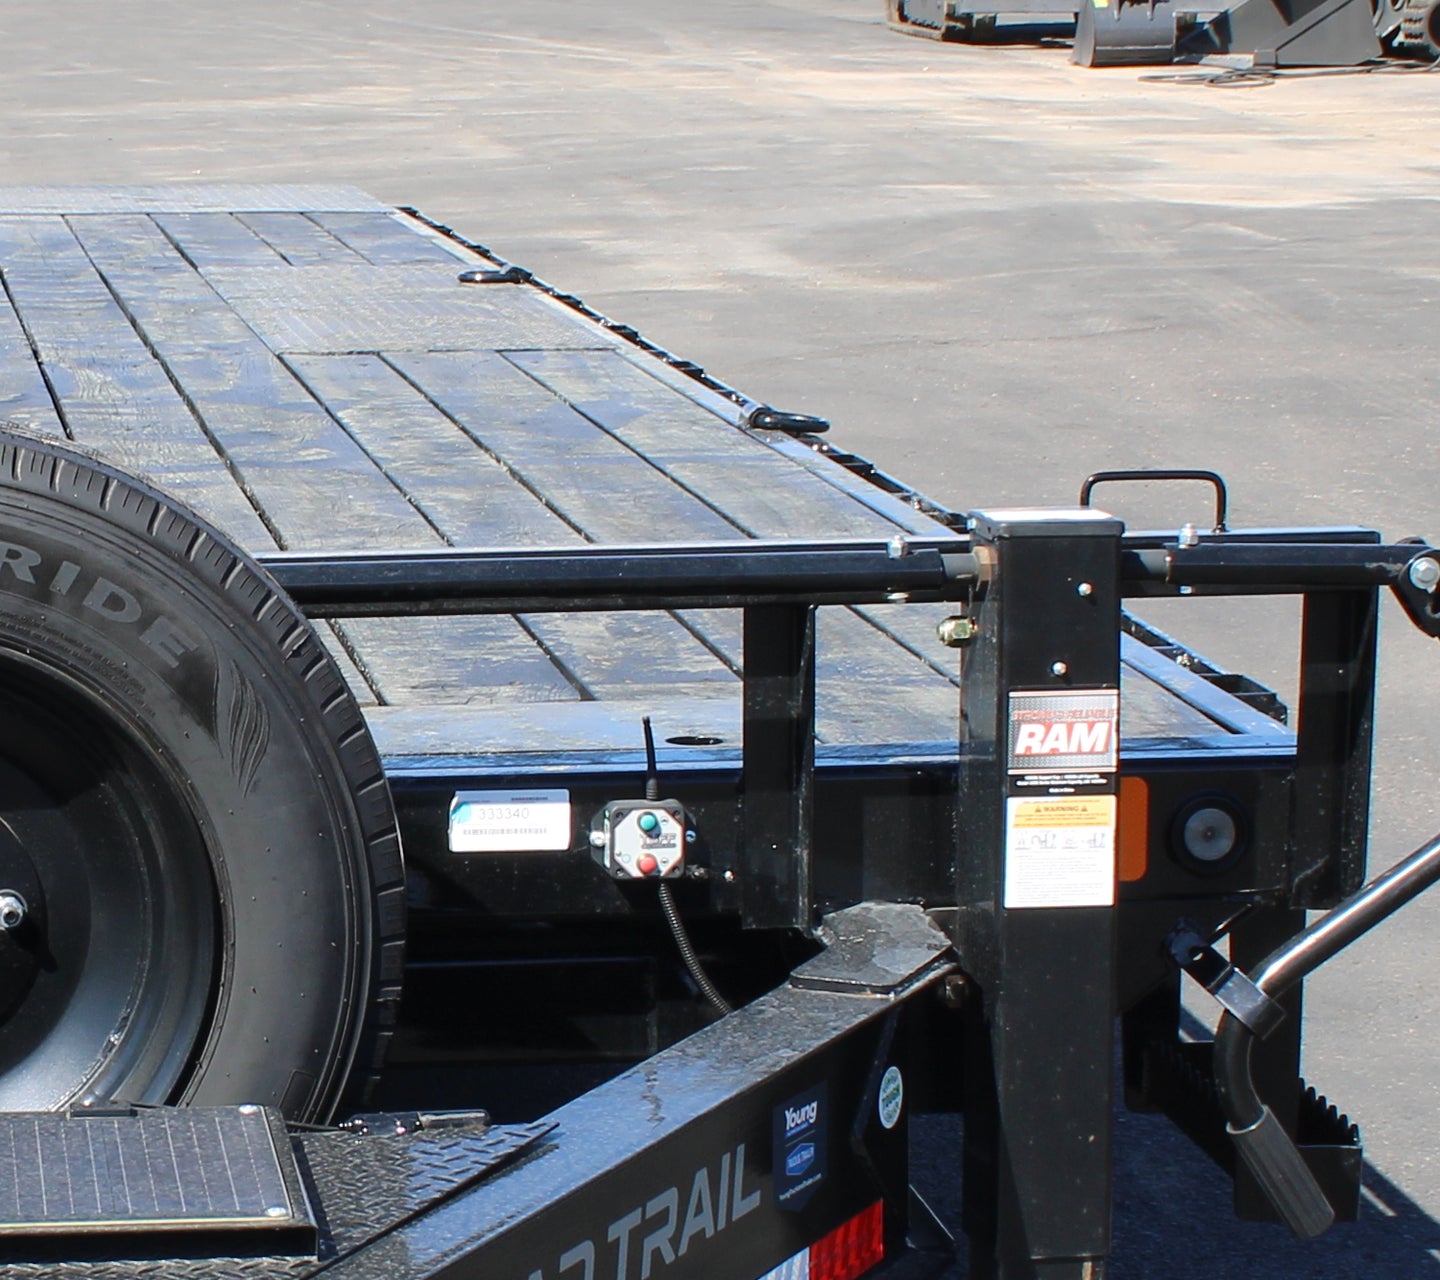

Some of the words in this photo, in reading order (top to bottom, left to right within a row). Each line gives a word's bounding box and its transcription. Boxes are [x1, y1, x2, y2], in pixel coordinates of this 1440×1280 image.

[1014, 721, 1110, 756] RAM
[479, 807, 530, 820] 333340
[784, 1100, 818, 1131] Young
